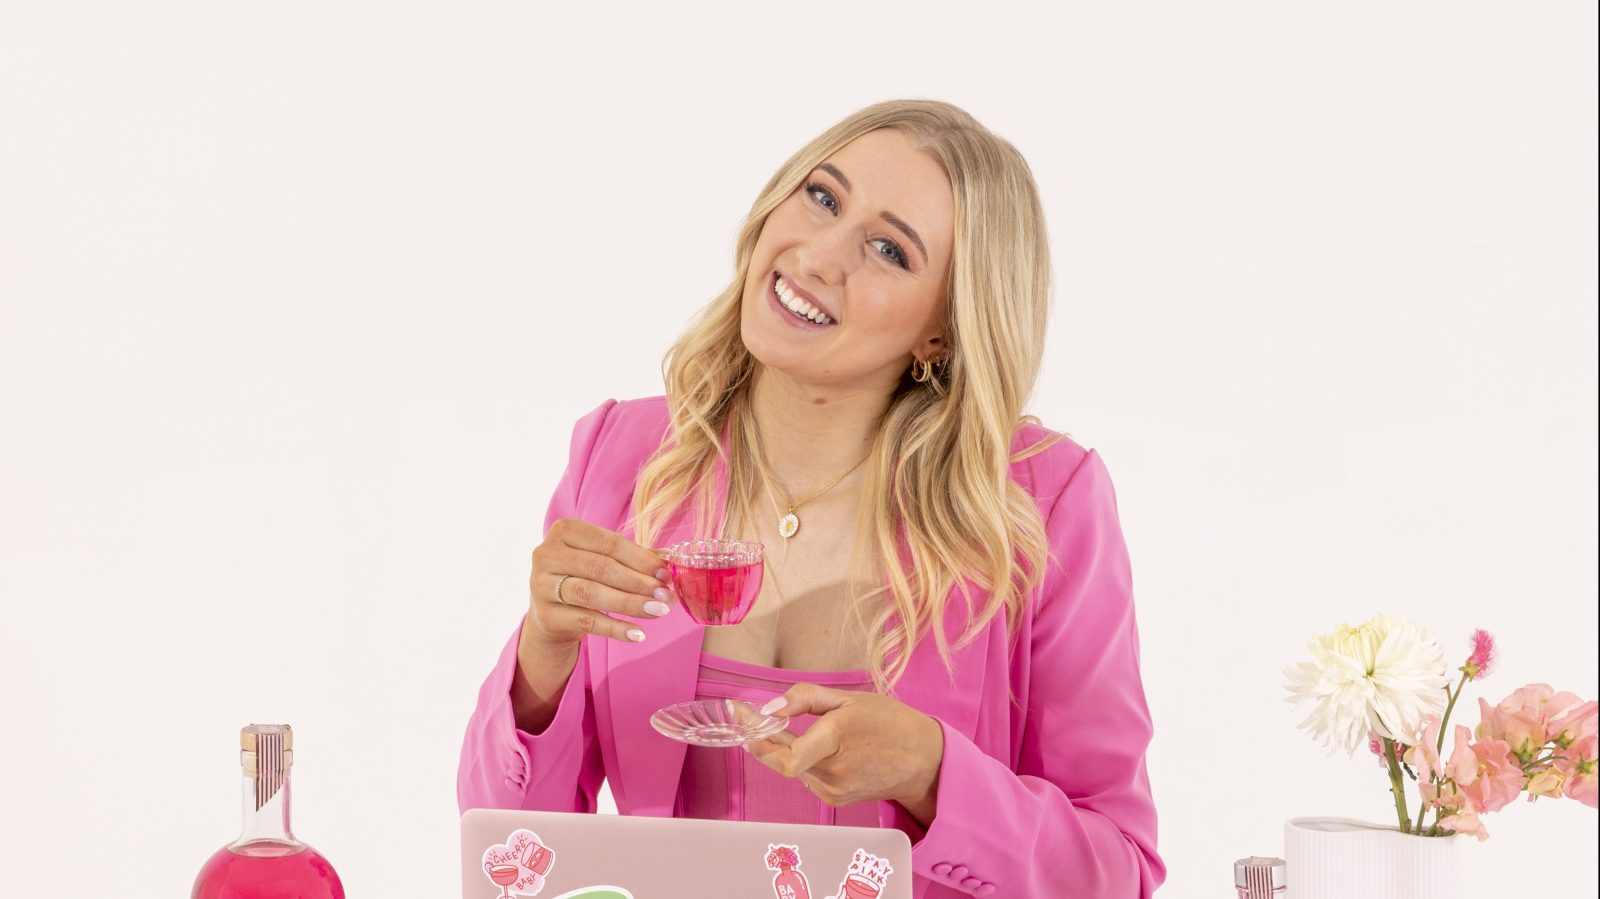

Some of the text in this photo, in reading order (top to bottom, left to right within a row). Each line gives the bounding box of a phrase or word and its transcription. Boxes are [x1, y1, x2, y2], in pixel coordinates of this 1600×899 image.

[493, 839, 526, 864] CHEERS
[851, 863, 884, 884] PINK
[855, 853, 891, 875] STAY
[516, 873, 536, 890] BABY
[778, 884, 795, 895] BA
